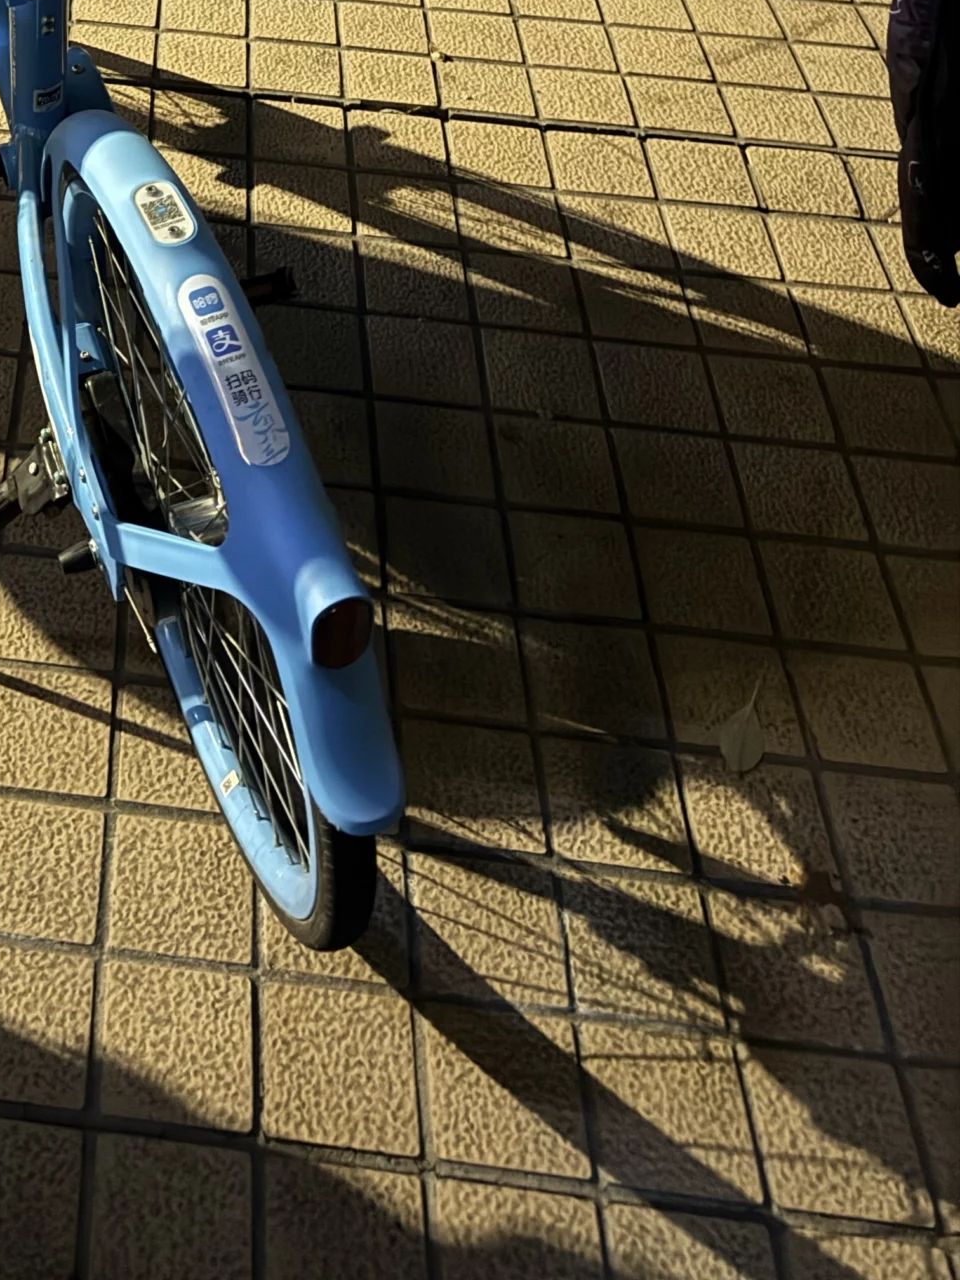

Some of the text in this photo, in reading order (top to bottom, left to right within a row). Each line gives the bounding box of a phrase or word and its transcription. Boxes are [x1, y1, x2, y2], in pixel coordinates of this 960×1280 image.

[192, 292, 219, 310] 哈啰
[225, 369, 257, 390] 扫码
[231, 384, 262, 406] 骑行
